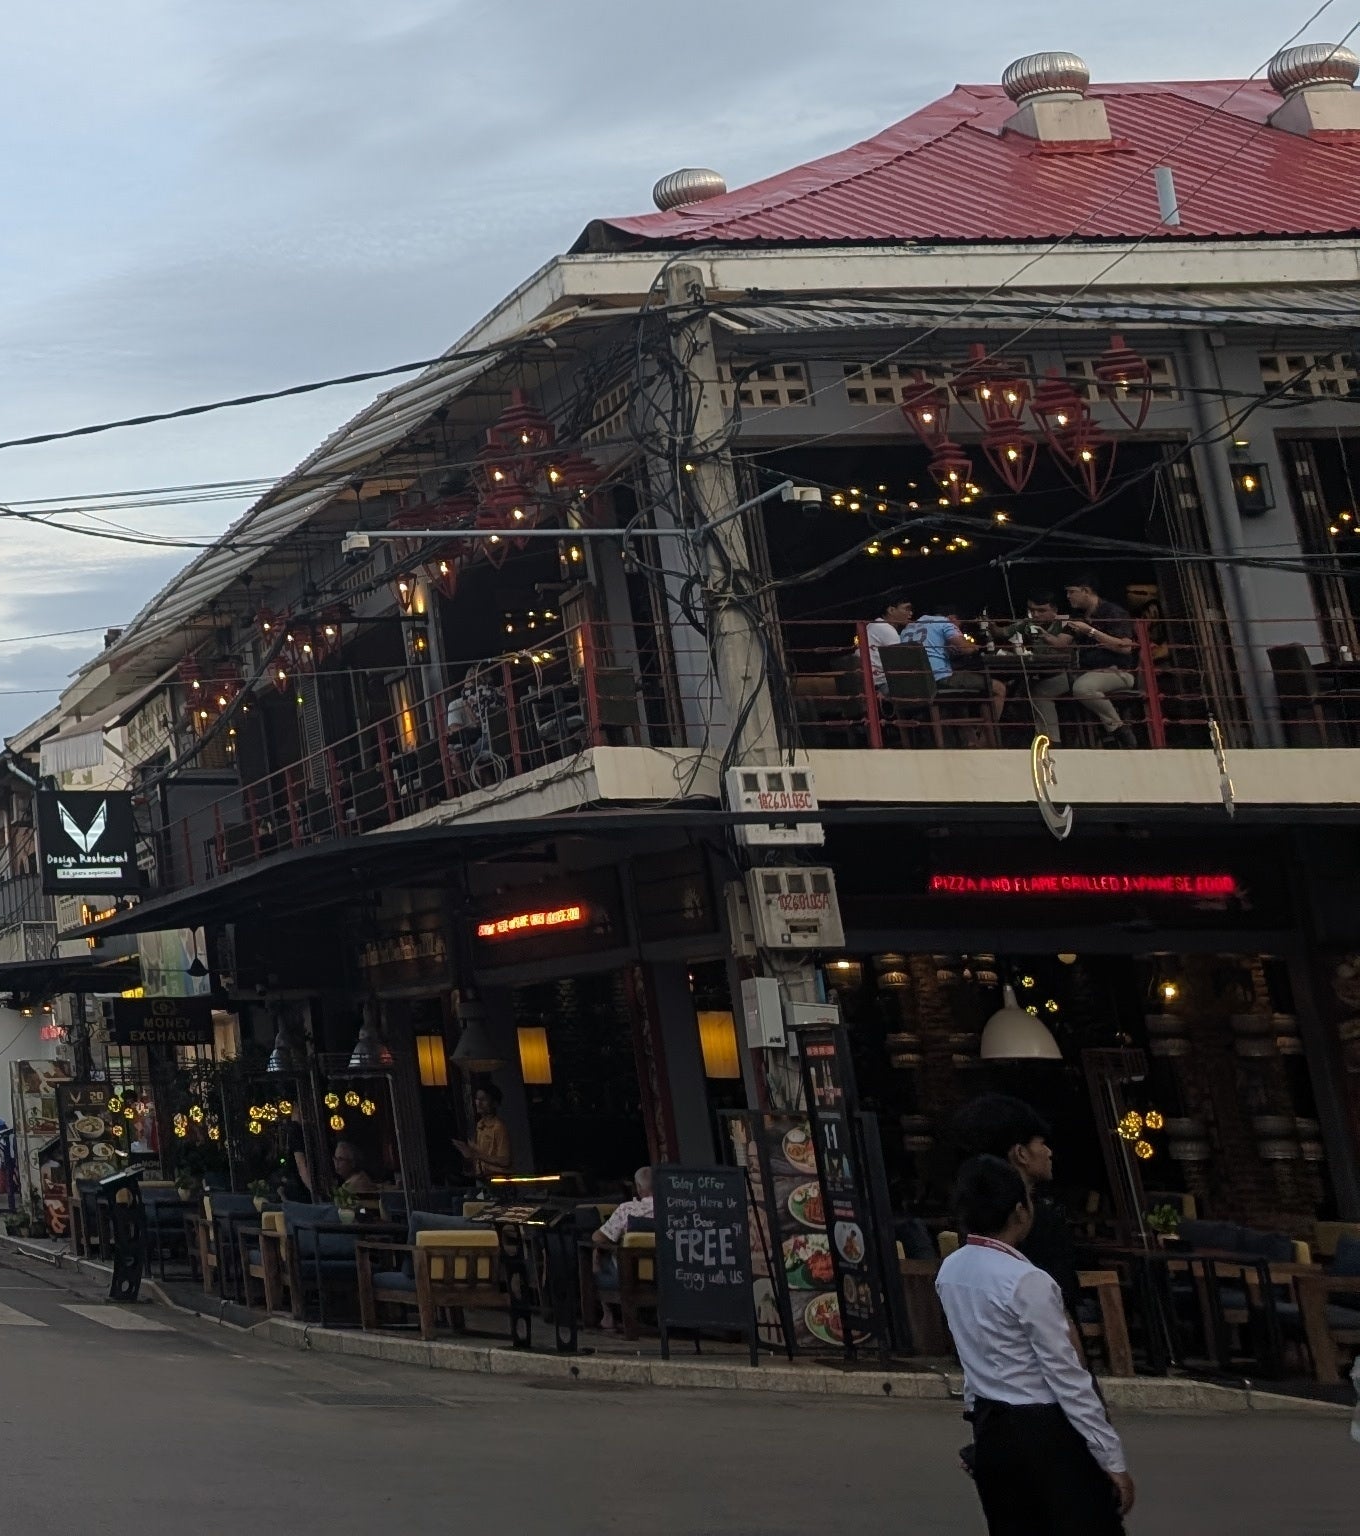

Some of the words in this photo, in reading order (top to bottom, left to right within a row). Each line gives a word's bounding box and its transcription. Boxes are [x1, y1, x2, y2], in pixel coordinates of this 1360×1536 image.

[933, 876, 978, 892] PIZZA
[1013, 876, 1059, 892] FLAME
[1061, 876, 1120, 892] GRILLED
[143, 1017, 192, 1029] MONEY
[129, 1030, 208, 1042] EXCHANGE
